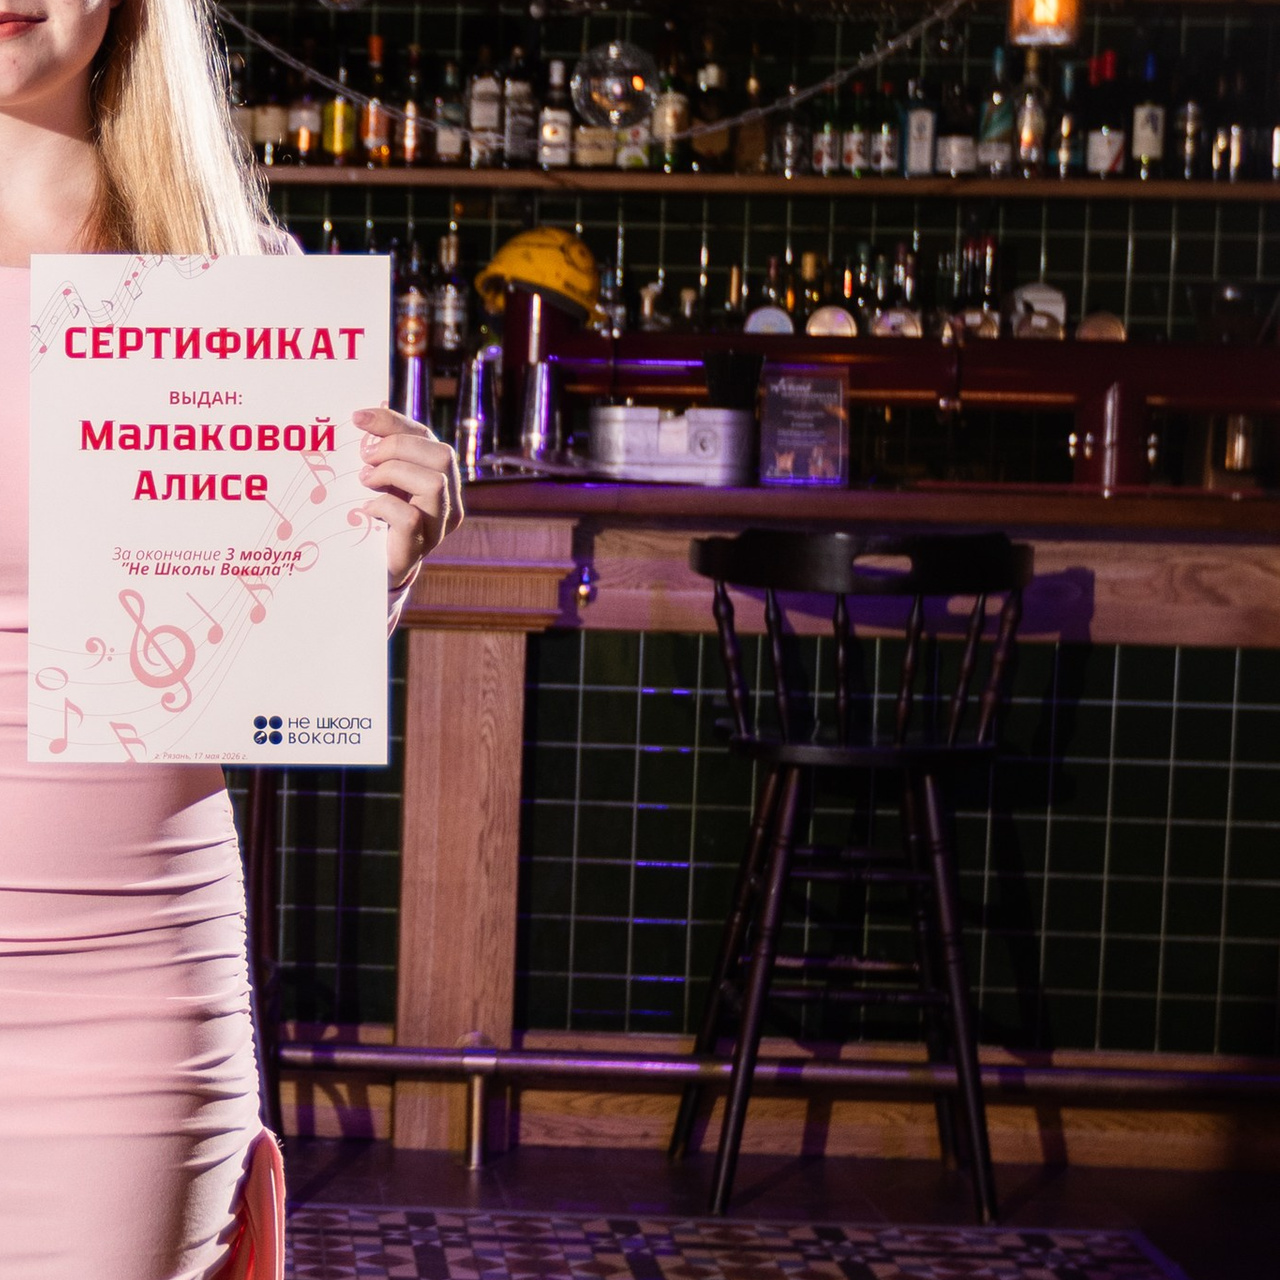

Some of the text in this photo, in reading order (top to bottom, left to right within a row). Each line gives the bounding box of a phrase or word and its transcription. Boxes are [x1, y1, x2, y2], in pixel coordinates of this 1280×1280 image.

[64, 326, 365, 360] СЕРТИФИКАТ
[169, 391, 243, 408] ВЫДАН:
[78, 417, 337, 451] Малаковой
[131, 470, 268, 501] Алисе
[112, 547, 302, 564] За окончание 3 модуля
[154, 562, 215, 576] Школы
[288, 717, 372, 729] не школа
[288, 731, 361, 745] вокала
[194, 752, 203, 760] 17
[222, 752, 240, 760] 2026
